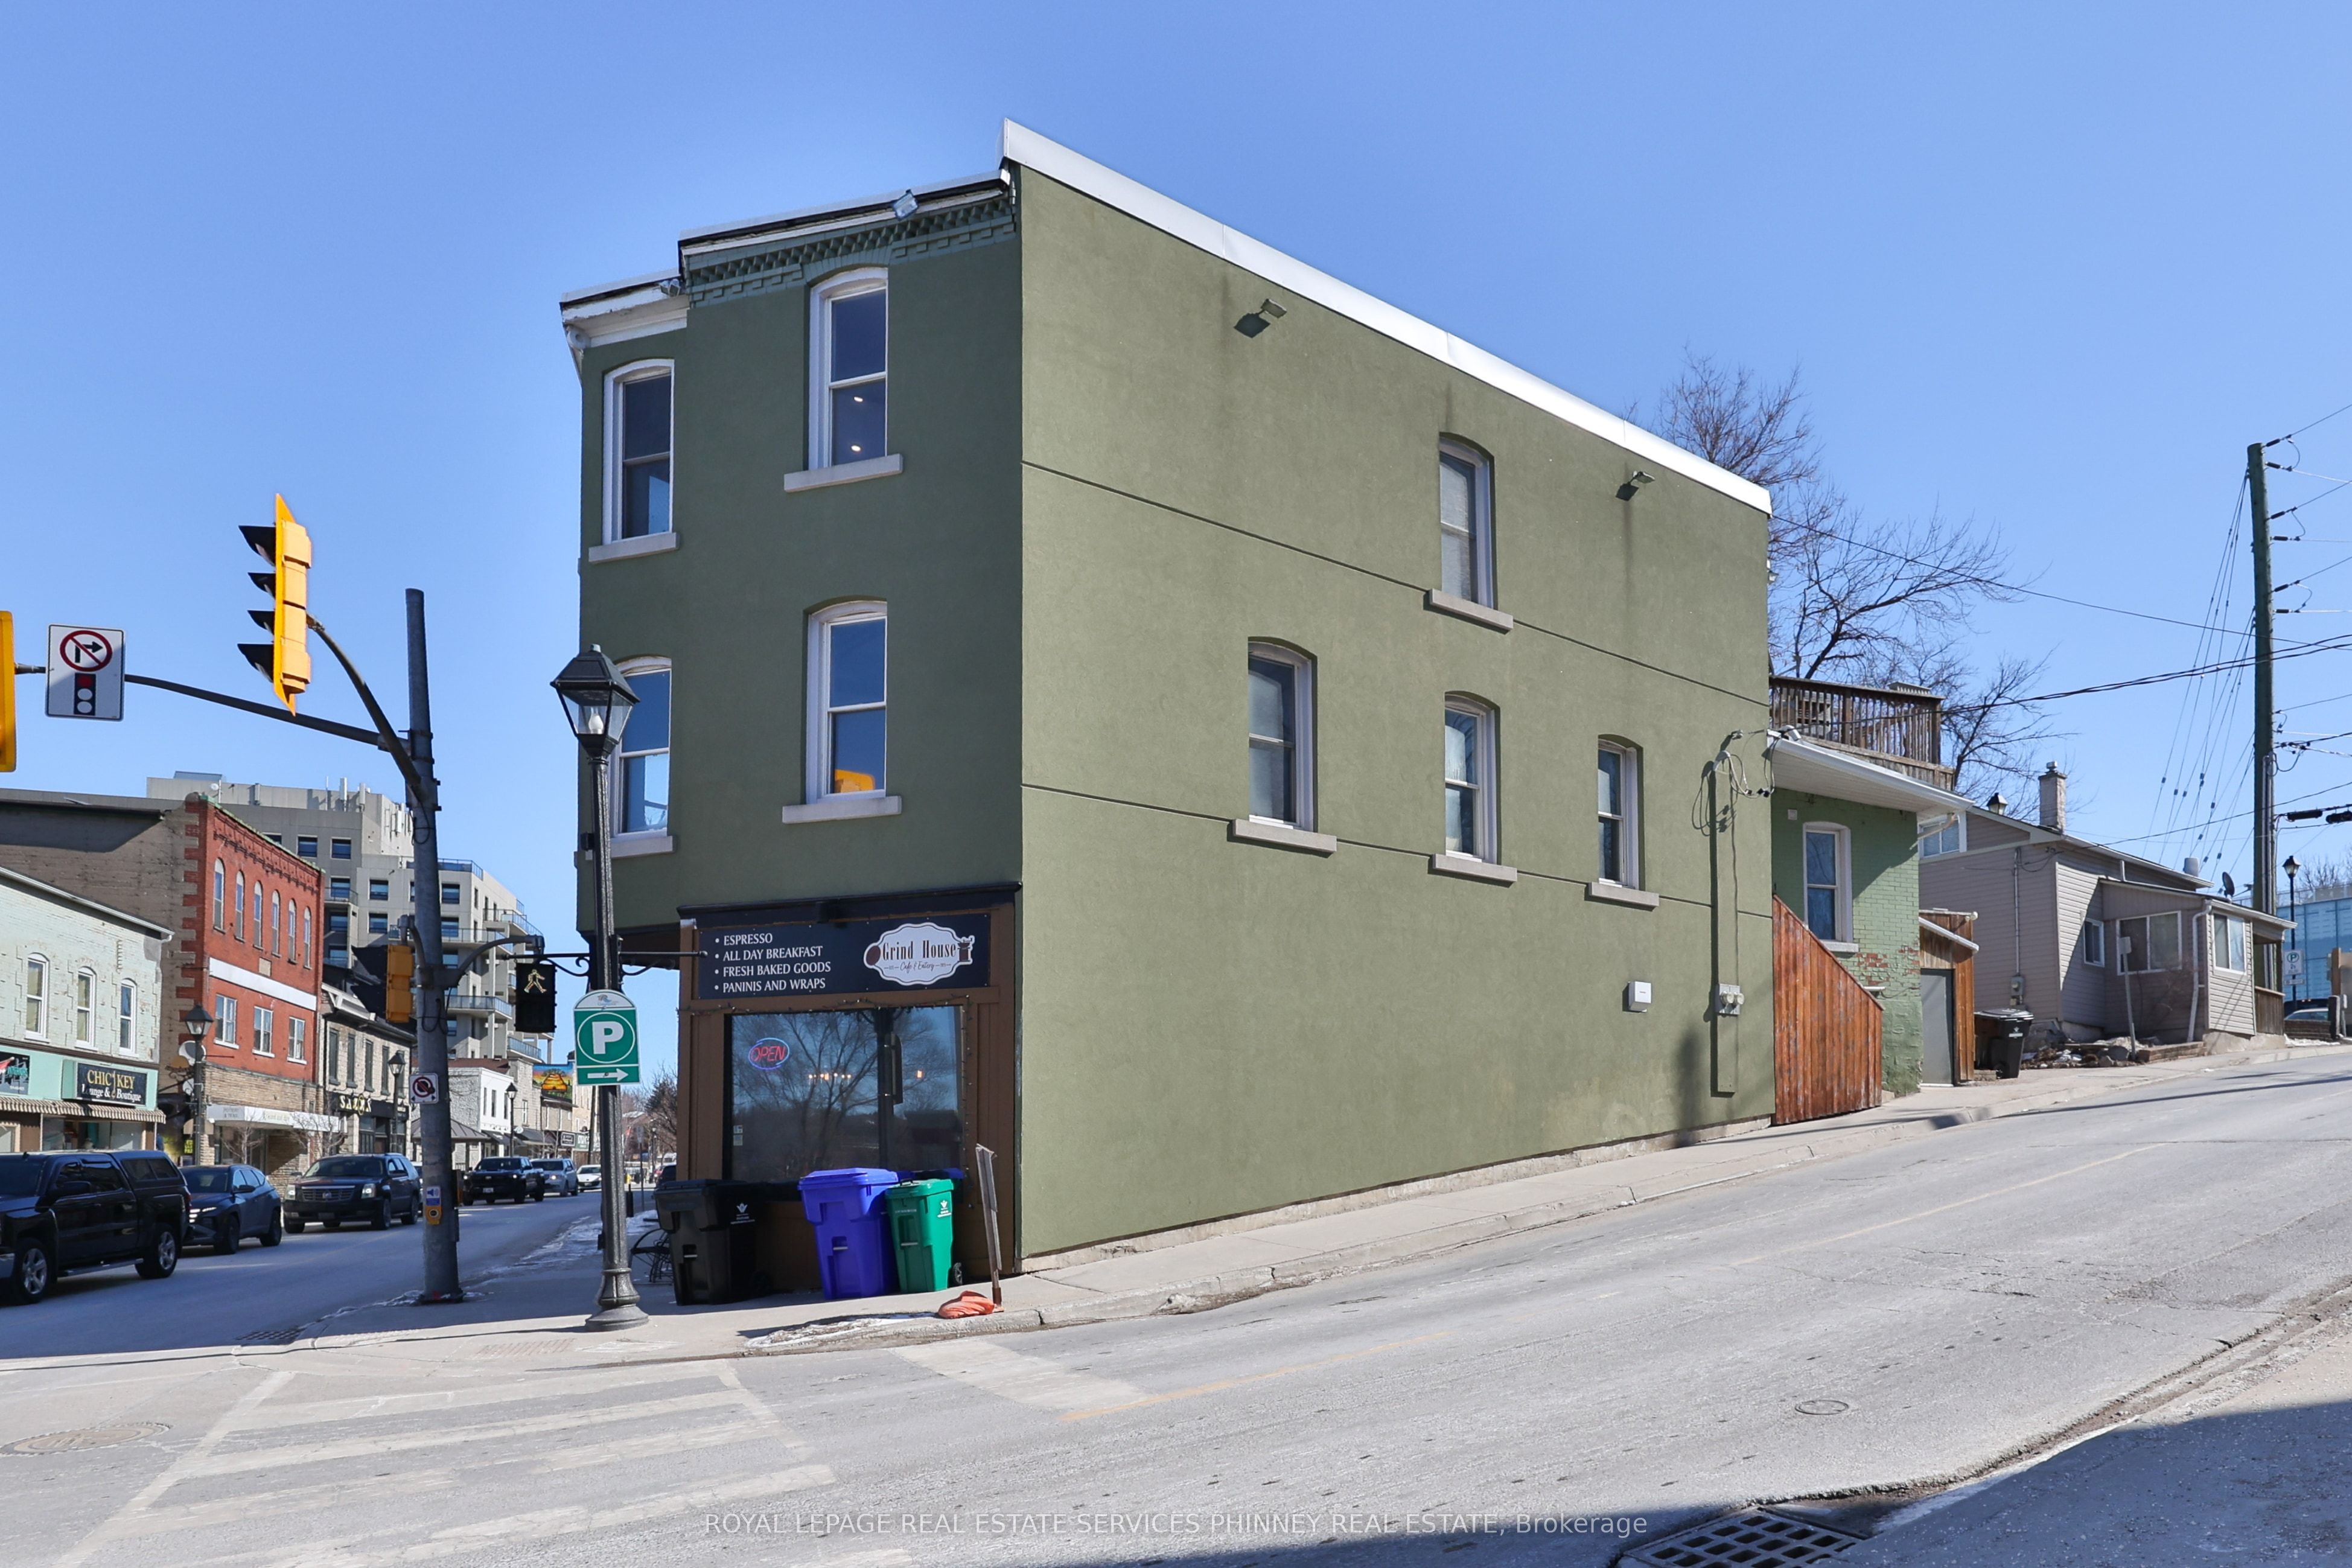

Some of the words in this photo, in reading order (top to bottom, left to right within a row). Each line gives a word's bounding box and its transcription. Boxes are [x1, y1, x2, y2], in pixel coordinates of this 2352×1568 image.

[724, 932, 773, 946] ESPRESSO
[723, 950, 741, 961] ALL
[743, 949, 763, 961] DAY
[766, 946, 823, 960] BREAKFAST
[882, 940, 914, 961] Grind
[923, 940, 957, 959] House
[723, 965, 754, 977] FRESH
[757, 964, 791, 975] BAKED
[794, 961, 831, 974] GOODS
[723, 980, 762, 993] PANINIS
[764, 980, 786, 991] AND
[789, 978, 826, 990] WRAPS
[591, 1021, 624, 1055] P
[751, 1045, 786, 1062] OPEN
[87, 1069, 112, 1086] CHIC
[117, 1074, 135, 1089] KEY
[104, 1086, 110, 1098] &
[116, 1088, 142, 1103] Boutique
